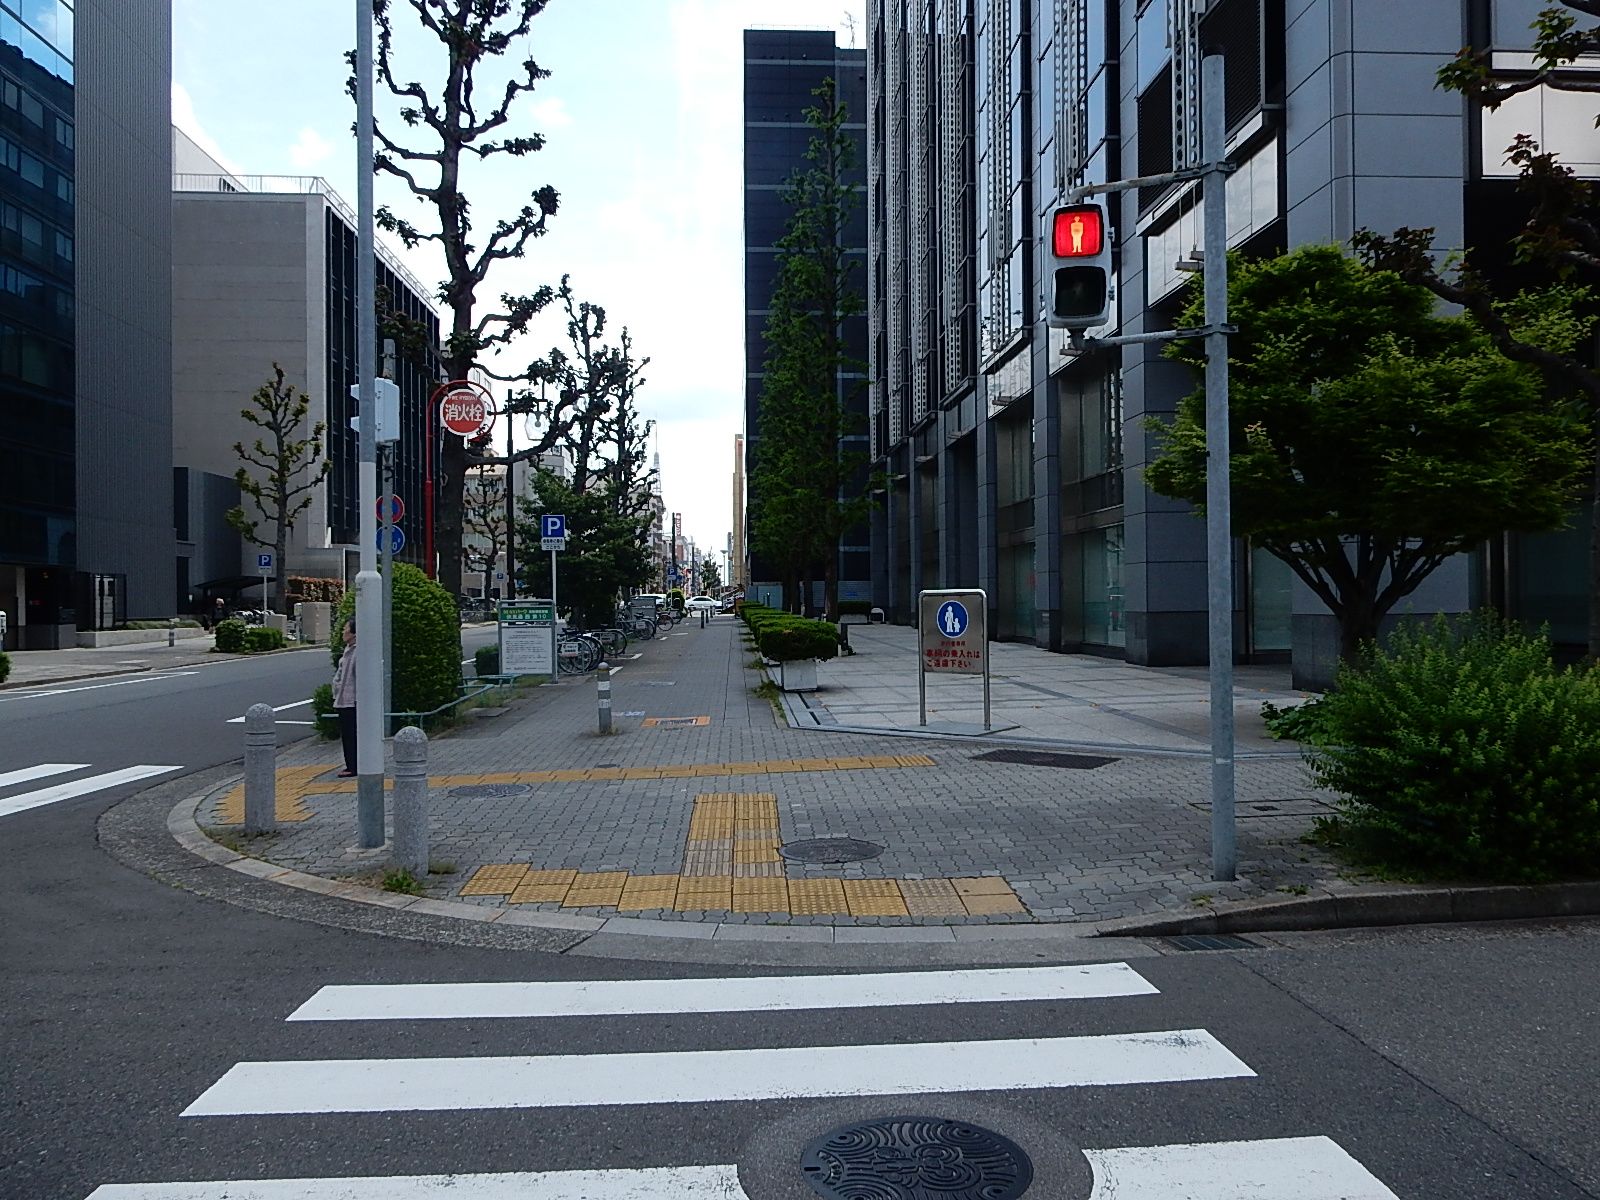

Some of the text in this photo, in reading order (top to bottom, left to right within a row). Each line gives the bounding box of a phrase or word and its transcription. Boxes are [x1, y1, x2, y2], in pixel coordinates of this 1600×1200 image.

[445, 403, 483, 422] 消火栓
[547, 517, 561, 536] P
[262, 556, 270, 566] P
